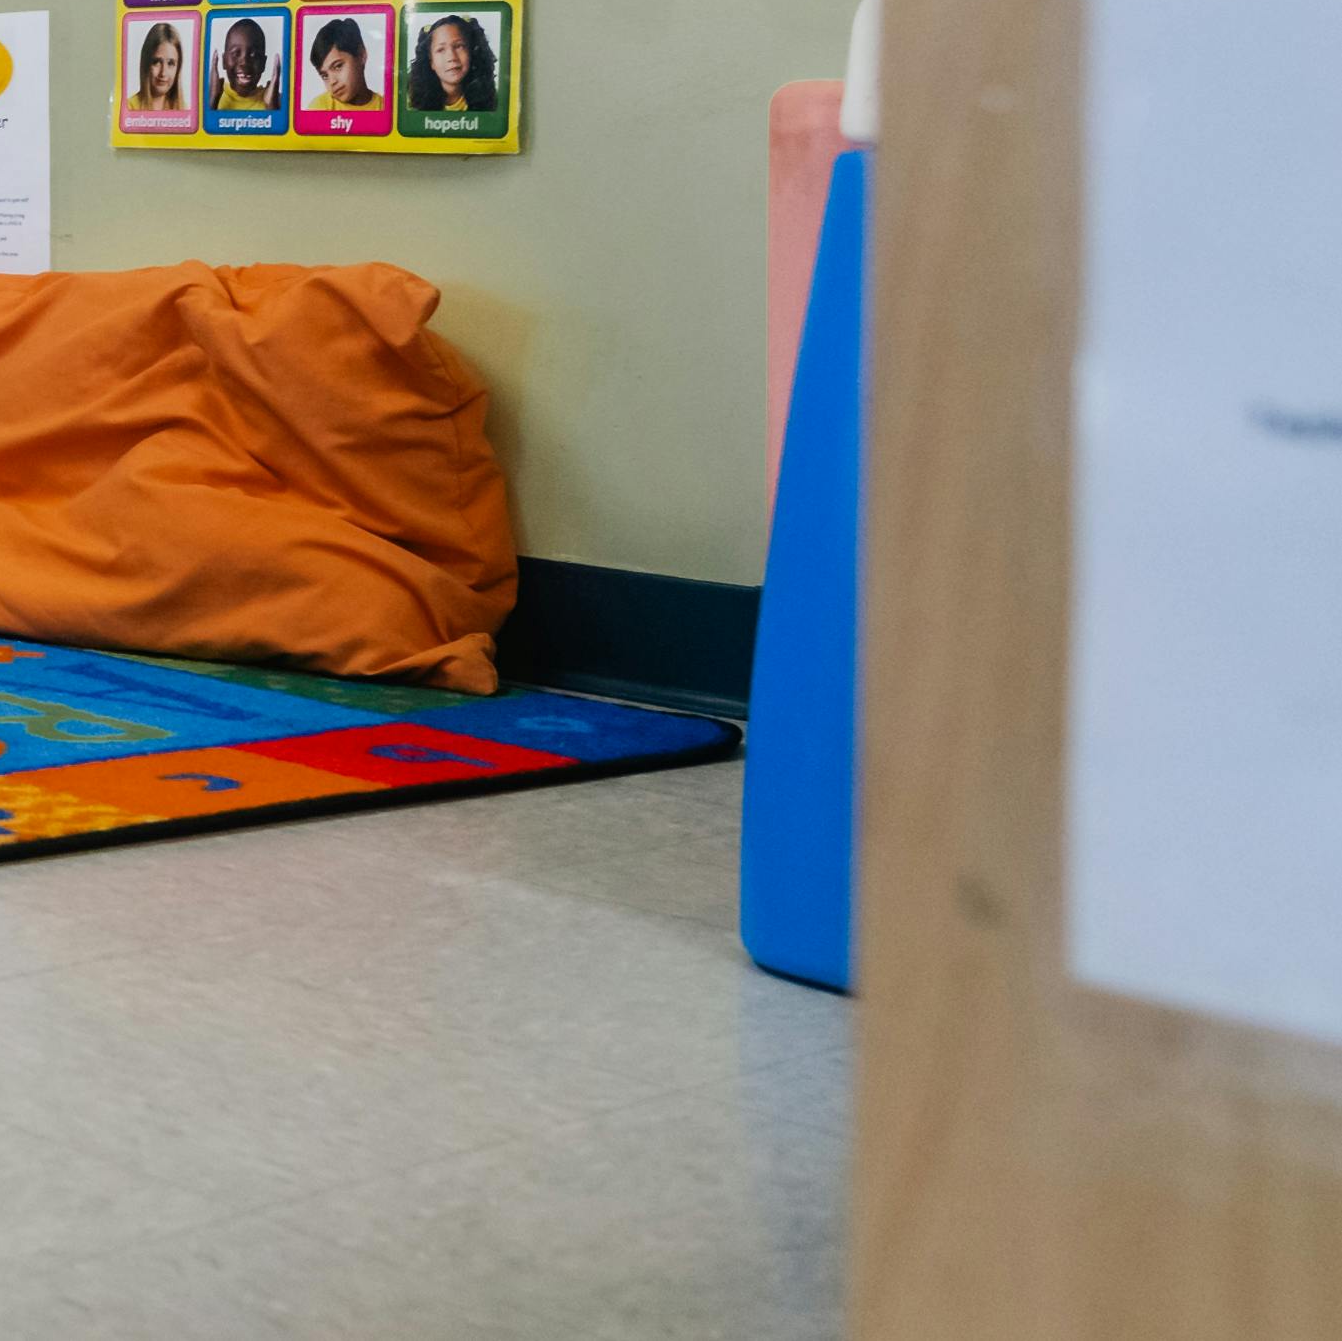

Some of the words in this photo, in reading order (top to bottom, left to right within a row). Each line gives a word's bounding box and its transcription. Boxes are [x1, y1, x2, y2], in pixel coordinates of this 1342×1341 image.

[125, 115, 191, 129] embarrassed
[219, 115, 272, 131] surprised
[330, 116, 353, 132] shy
[424, 116, 479, 133] hopeful
